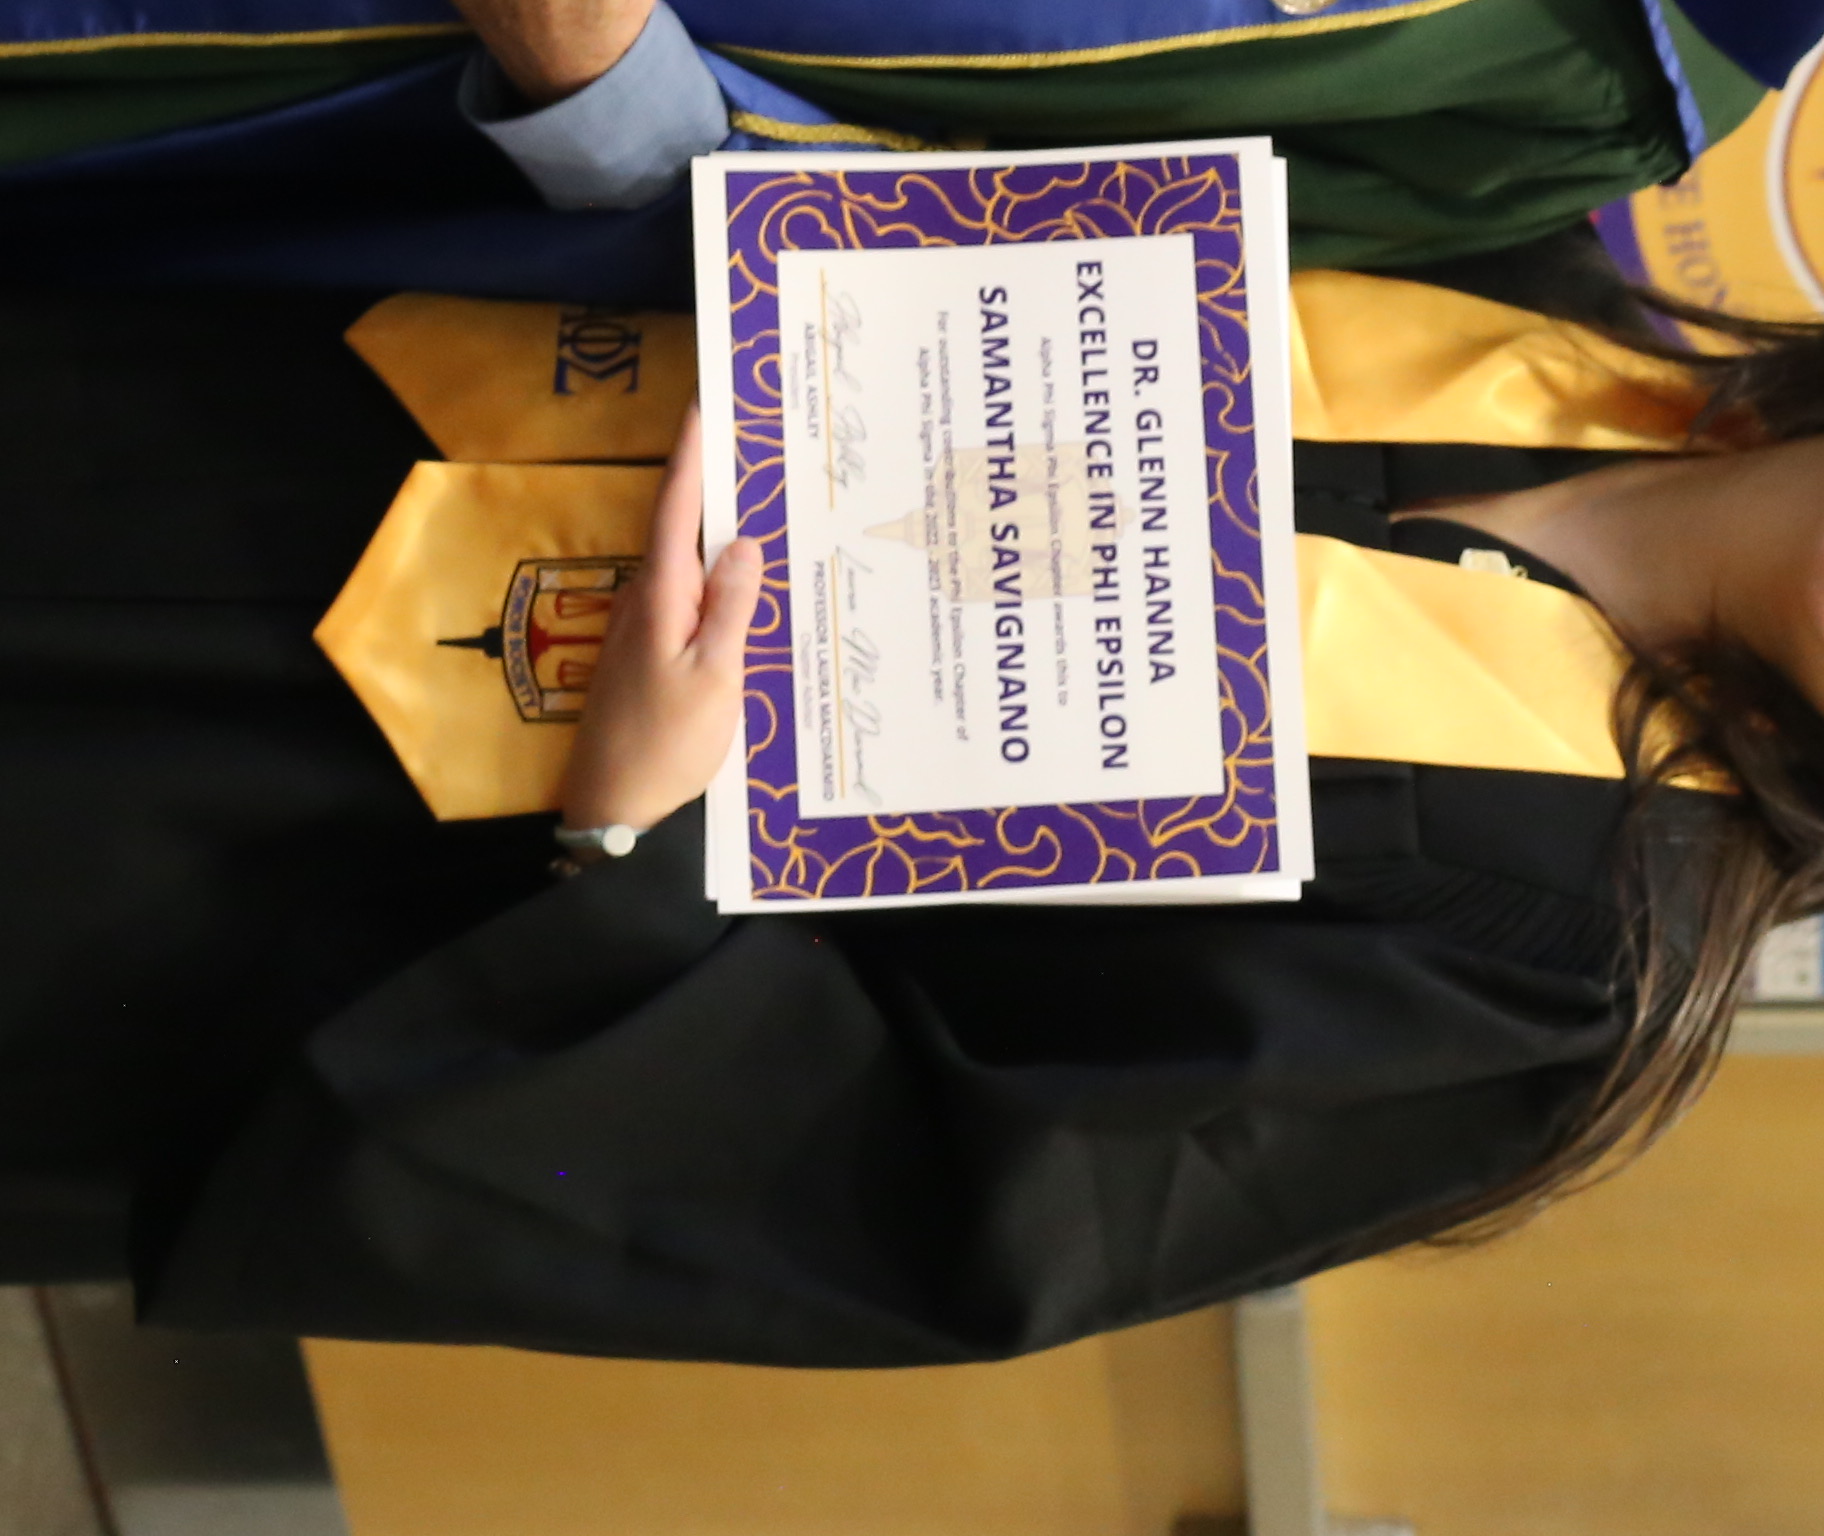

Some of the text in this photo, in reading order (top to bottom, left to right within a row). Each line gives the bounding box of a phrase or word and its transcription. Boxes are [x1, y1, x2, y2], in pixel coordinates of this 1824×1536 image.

[936, 310, 948, 332] For
[804, 322, 819, 440] ABIGAIL ASHLEY
[916, 347, 931, 388] Alpha
[936, 338, 952, 425] outstanding
[920, 393, 932, 415] Phi
[918, 420, 934, 462] Sigma
[977, 286, 1029, 763] SAMANTHA SAVIGNANO
[1039, 337, 1067, 706] Alpha Phi Sigma Phi Epsilon Chapter awards this to
[1075, 260, 1128, 770] EXCELLENCE IN PHI EPSILON
[1131, 339, 1175, 685] DR. GLENN HANNA
[946, 531, 958, 546] to
[947, 550, 960, 576] the
[926, 559, 941, 591] 2023
[948, 579, 962, 602] Phi
[929, 596, 944, 664] academic
[949, 607, 966, 658] Epsilon
[812, 560, 834, 802] PROFESSOR LAURA MACDIARMID
[951, 663, 968, 720] Chapter
[955, 725, 969, 741] of
